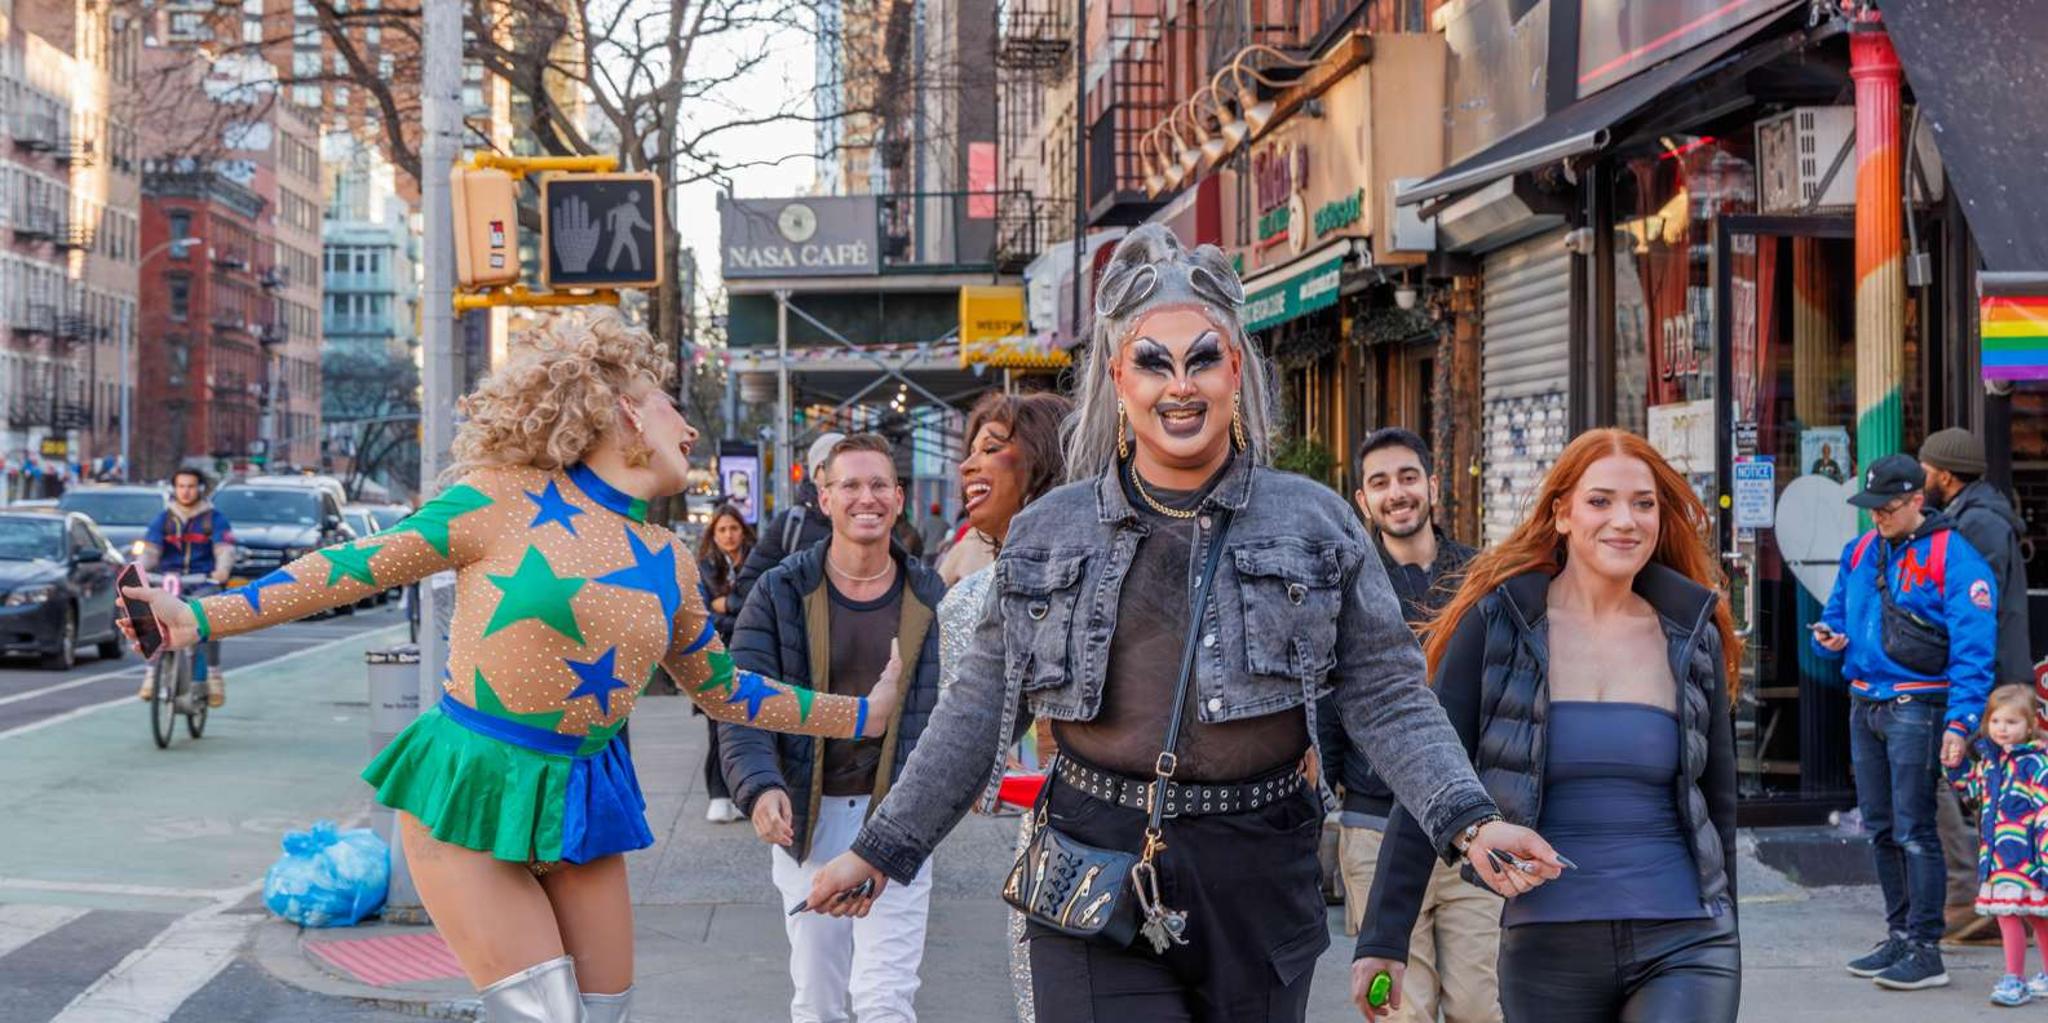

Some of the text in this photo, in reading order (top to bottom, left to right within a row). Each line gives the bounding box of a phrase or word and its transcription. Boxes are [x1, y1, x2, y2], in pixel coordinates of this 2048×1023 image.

[729, 240, 869, 268] NASA CAFÉ
[1738, 465, 1771, 479] NOTICE
